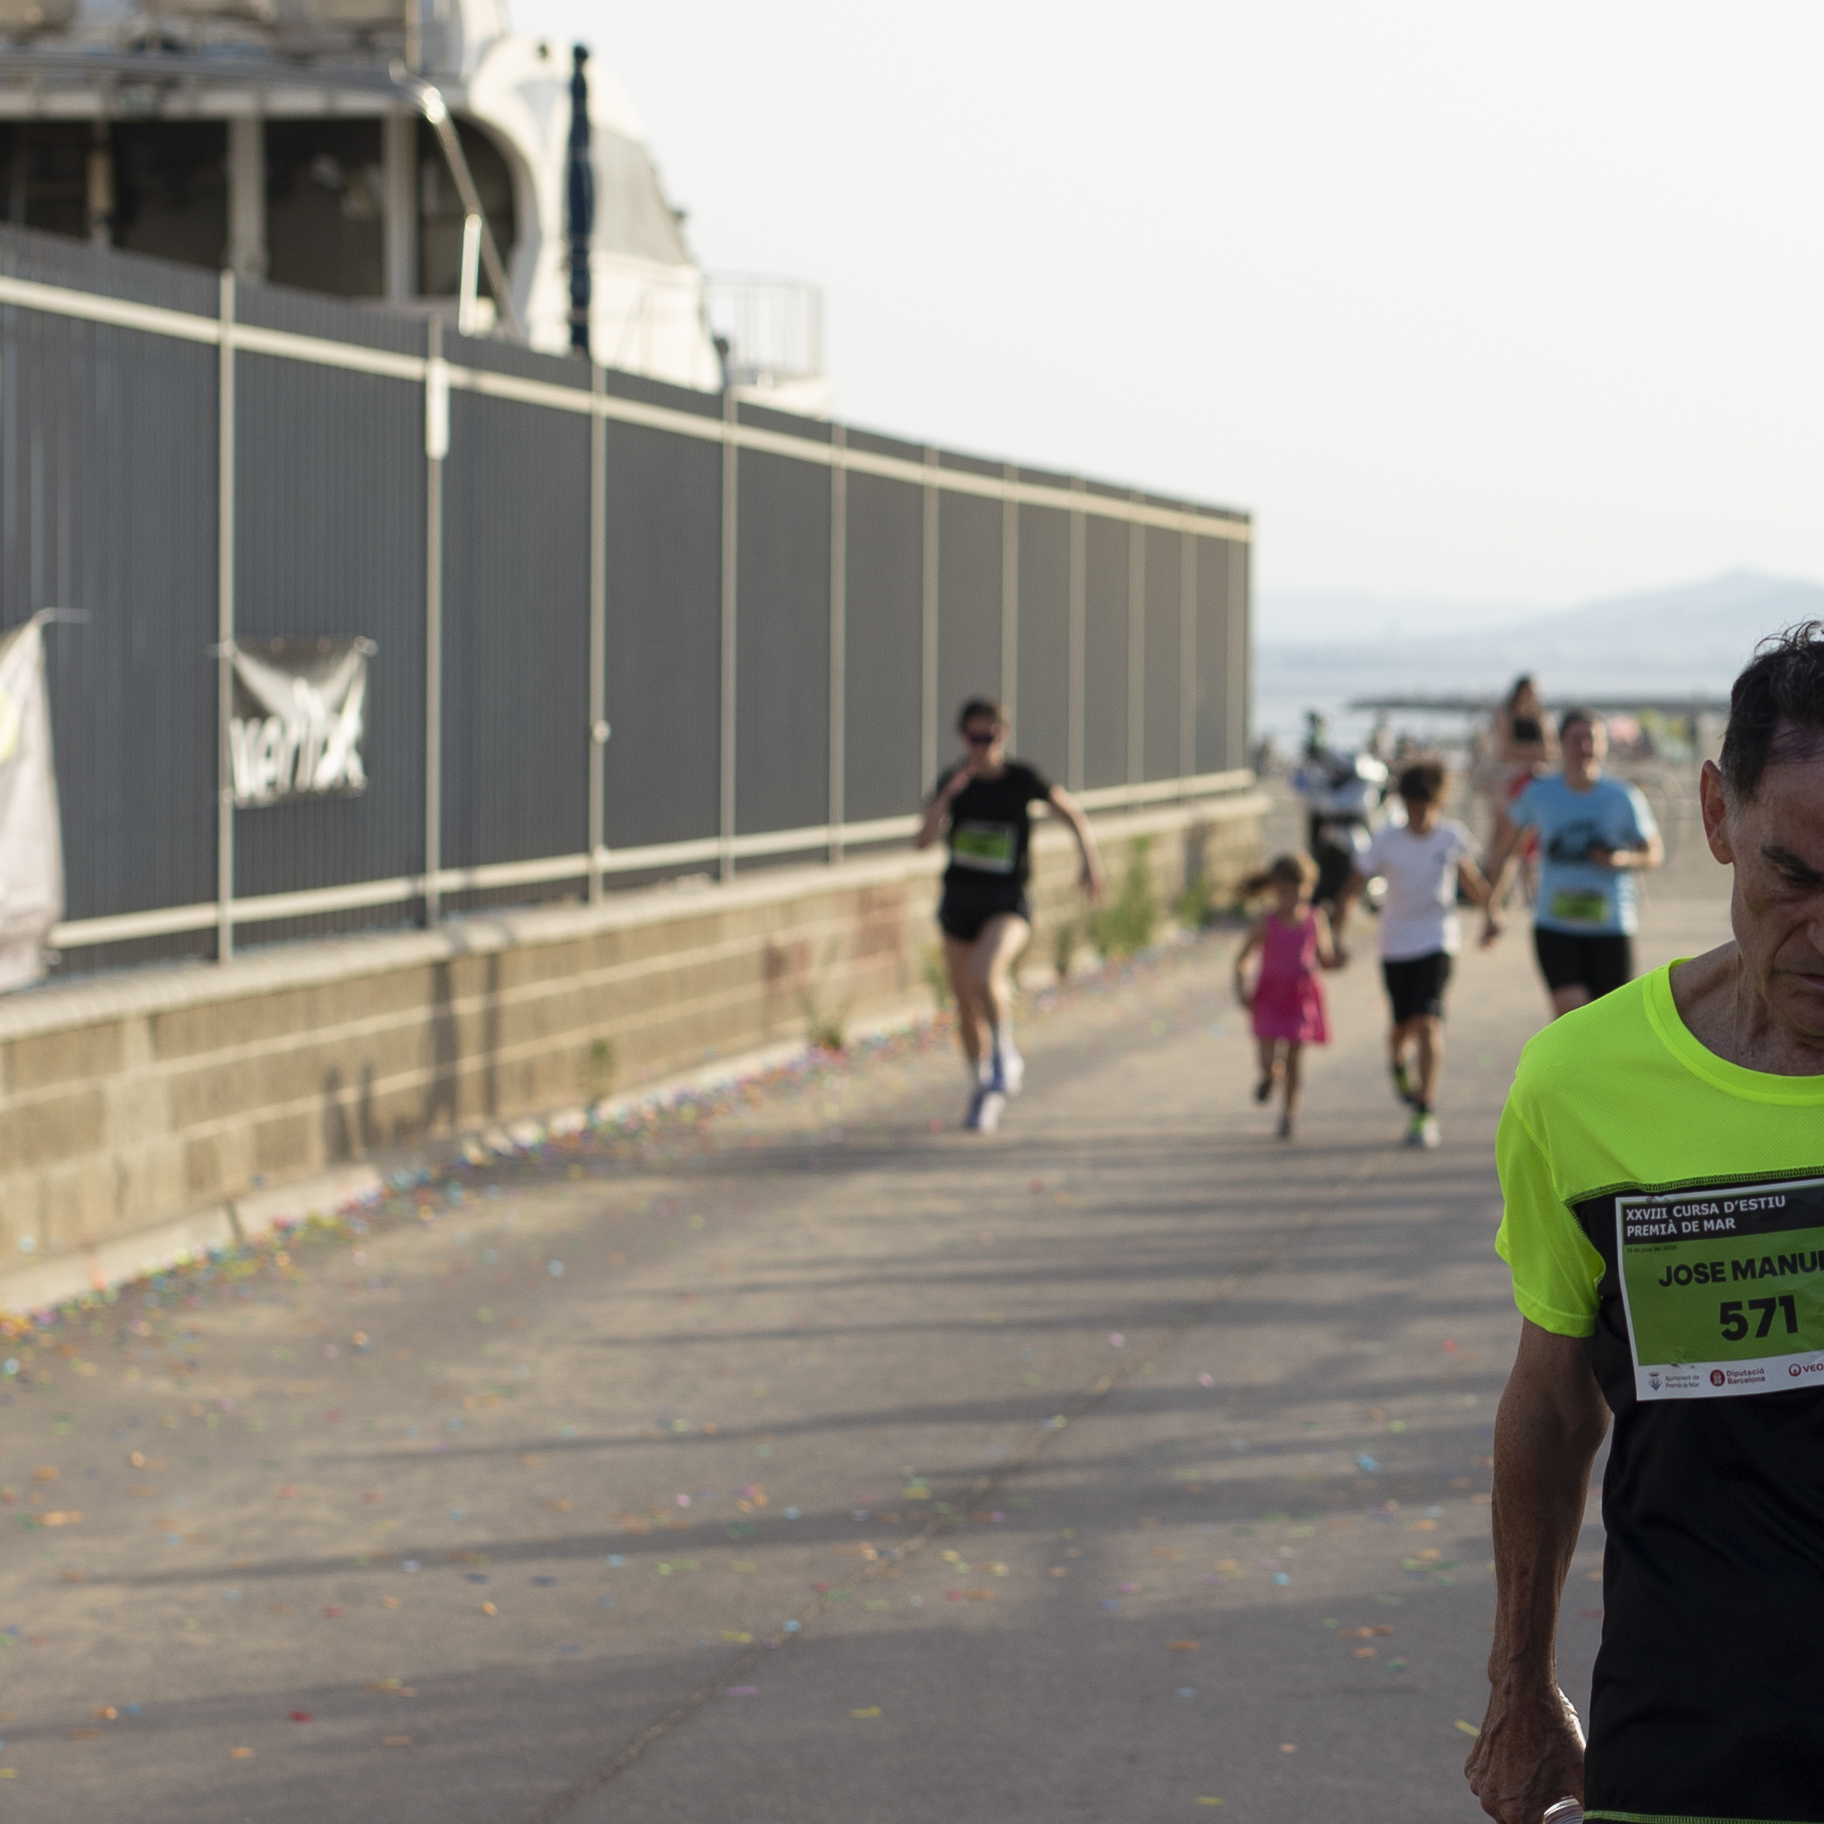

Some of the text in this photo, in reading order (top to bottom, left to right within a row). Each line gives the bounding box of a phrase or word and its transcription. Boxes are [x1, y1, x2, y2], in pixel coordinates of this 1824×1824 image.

[1626, 1195, 1787, 1221] XXVIII CURSA D'ESTIU
[1626, 1217, 1737, 1238] PREMIÀ DE MAR
[1658, 1261, 1727, 1287] JOSE
[1719, 1294, 1799, 1341] 571
[1726, 1368, 1765, 1378] Diputació
[1728, 1376, 1766, 1385] Barcelona
